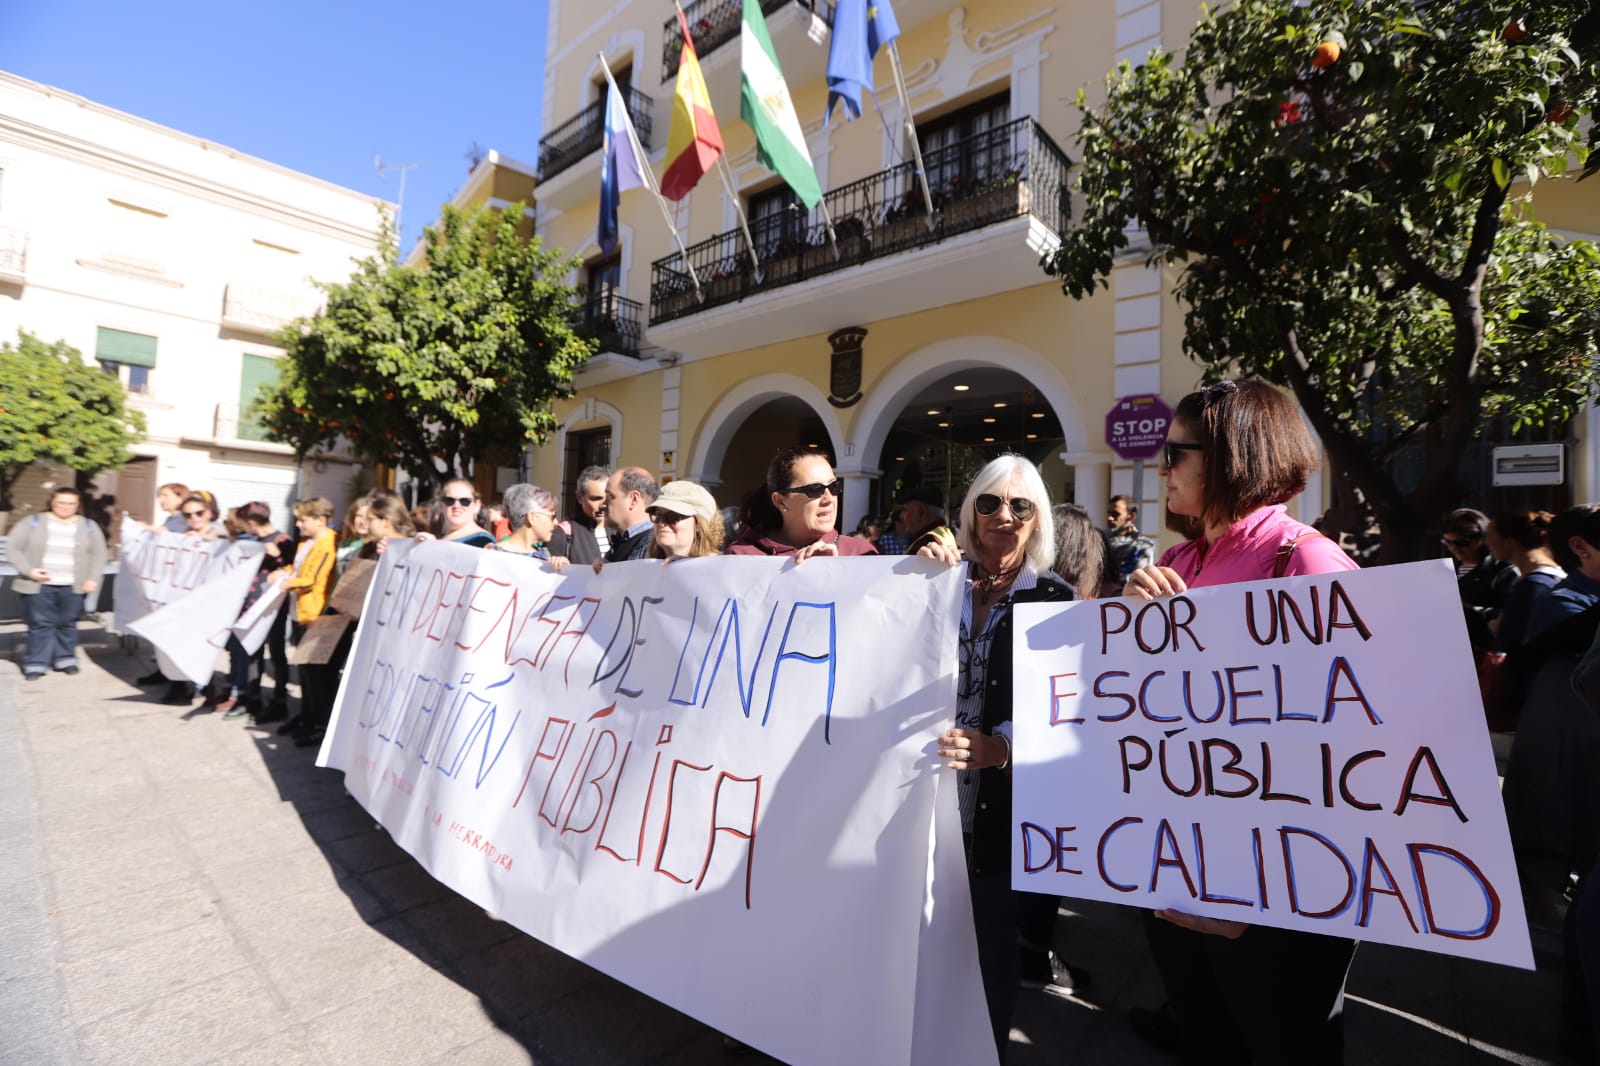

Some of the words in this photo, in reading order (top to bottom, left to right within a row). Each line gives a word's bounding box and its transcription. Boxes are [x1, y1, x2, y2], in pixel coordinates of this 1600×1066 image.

[1113, 418, 1166, 435] STOP
[376, 563, 423, 630] EN
[411, 568, 603, 691] DEFENSA
[589, 595, 664, 698] DE
[668, 595, 836, 746] UNA
[1101, 596, 1206, 655] POR
[1245, 580, 1372, 645] UNA
[1049, 656, 1384, 727] ESCUELA
[359, 659, 522, 790] EDUCACIÓN
[512, 701, 763, 910] PÚBLICA
[1118, 727, 1469, 824] PÚBLICA
[1020, 821, 1083, 876] DE
[1096, 816, 1502, 941] CALIDAD
